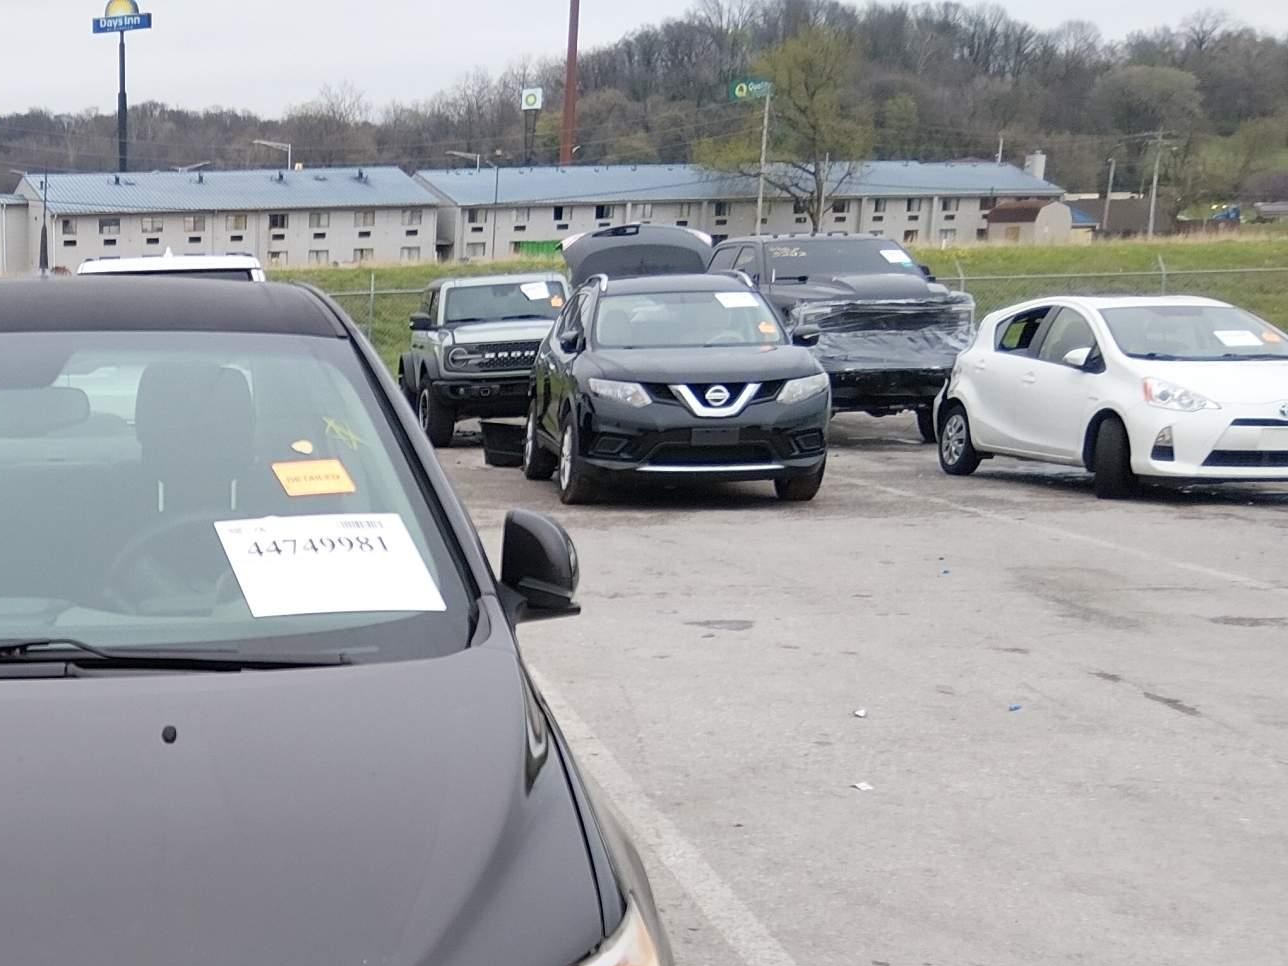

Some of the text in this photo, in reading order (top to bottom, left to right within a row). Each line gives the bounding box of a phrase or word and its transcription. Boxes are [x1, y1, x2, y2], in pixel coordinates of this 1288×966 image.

[100, 17, 123, 30] Days
[124, 15, 140, 25] Inn
[248, 535, 388, 557] 44749981
